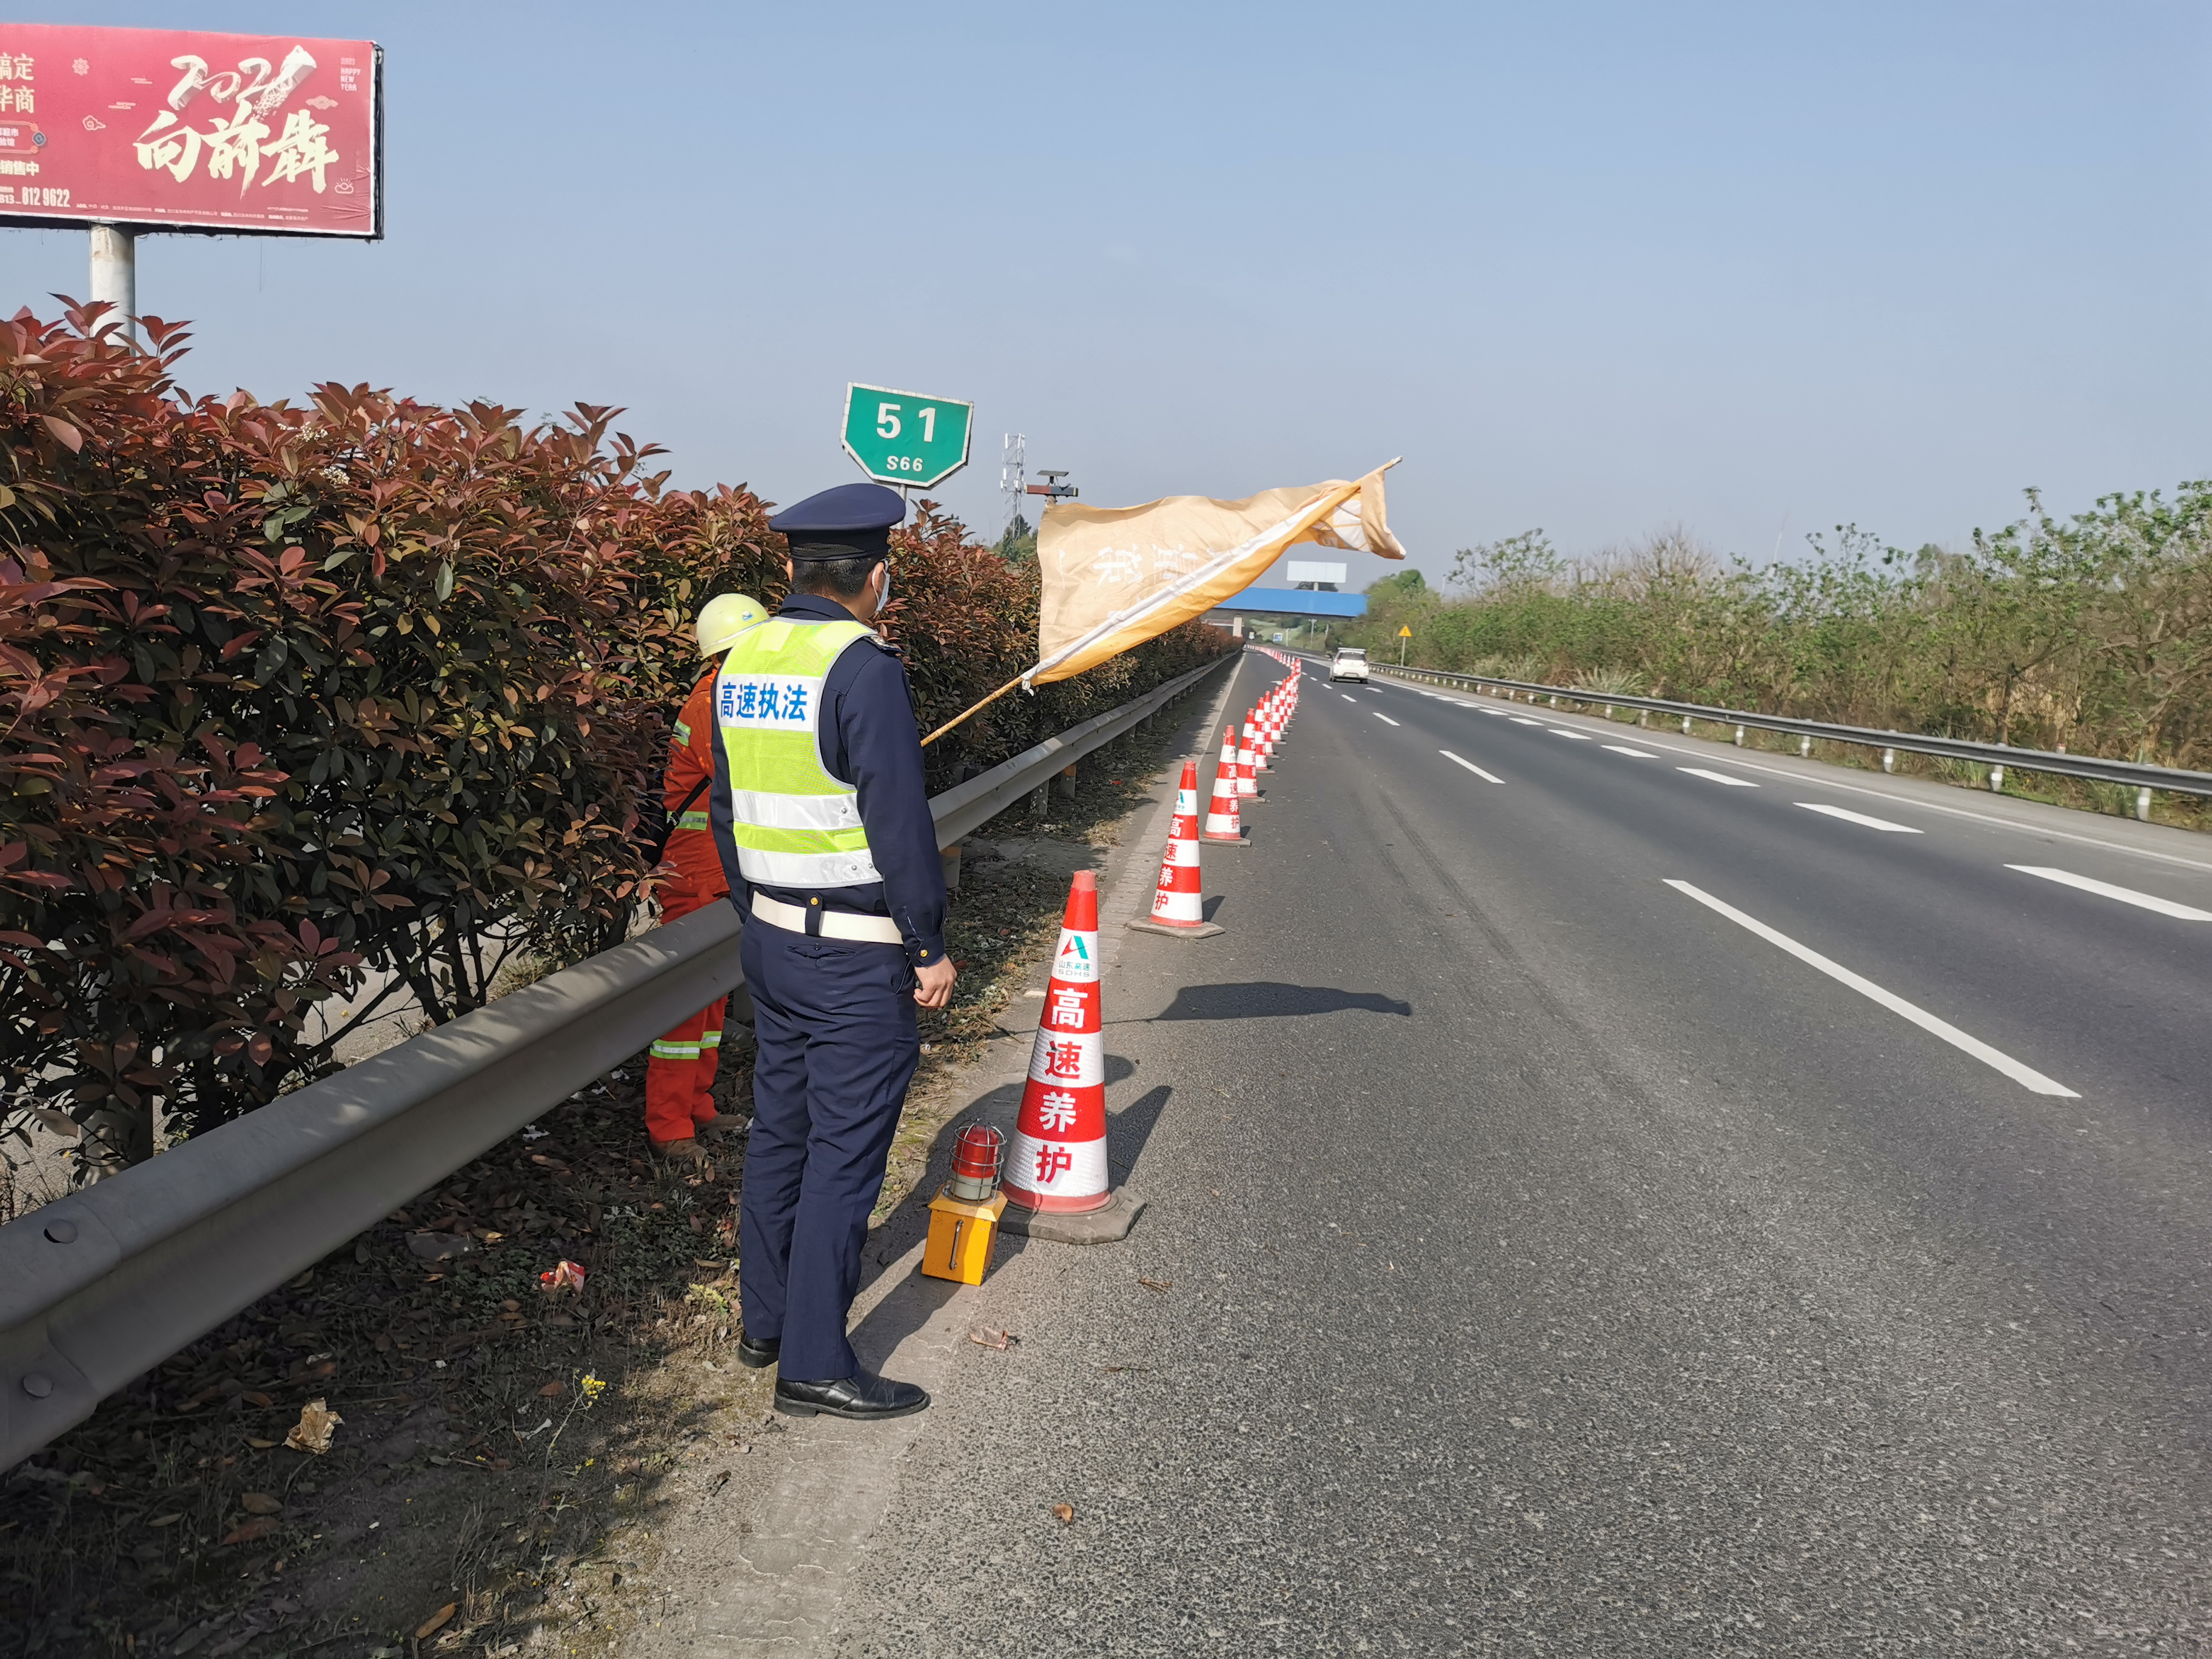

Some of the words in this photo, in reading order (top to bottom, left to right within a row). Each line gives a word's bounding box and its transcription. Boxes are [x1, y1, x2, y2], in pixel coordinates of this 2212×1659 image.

[340, 83, 357, 92] YEAR
[0, 84, 35, 113] 华商
[22, 187, 41, 206] 812
[42, 188, 71, 207] 9622
[886, 455, 923, 472] S66
[720, 682, 808, 722] 高速执法
[1155, 817, 1184, 910] 高速养护
[1057, 969, 1090, 977] SDHS
[1059, 960, 1090, 971] 山东高速
[1035, 988, 1088, 1183] 高速养护
